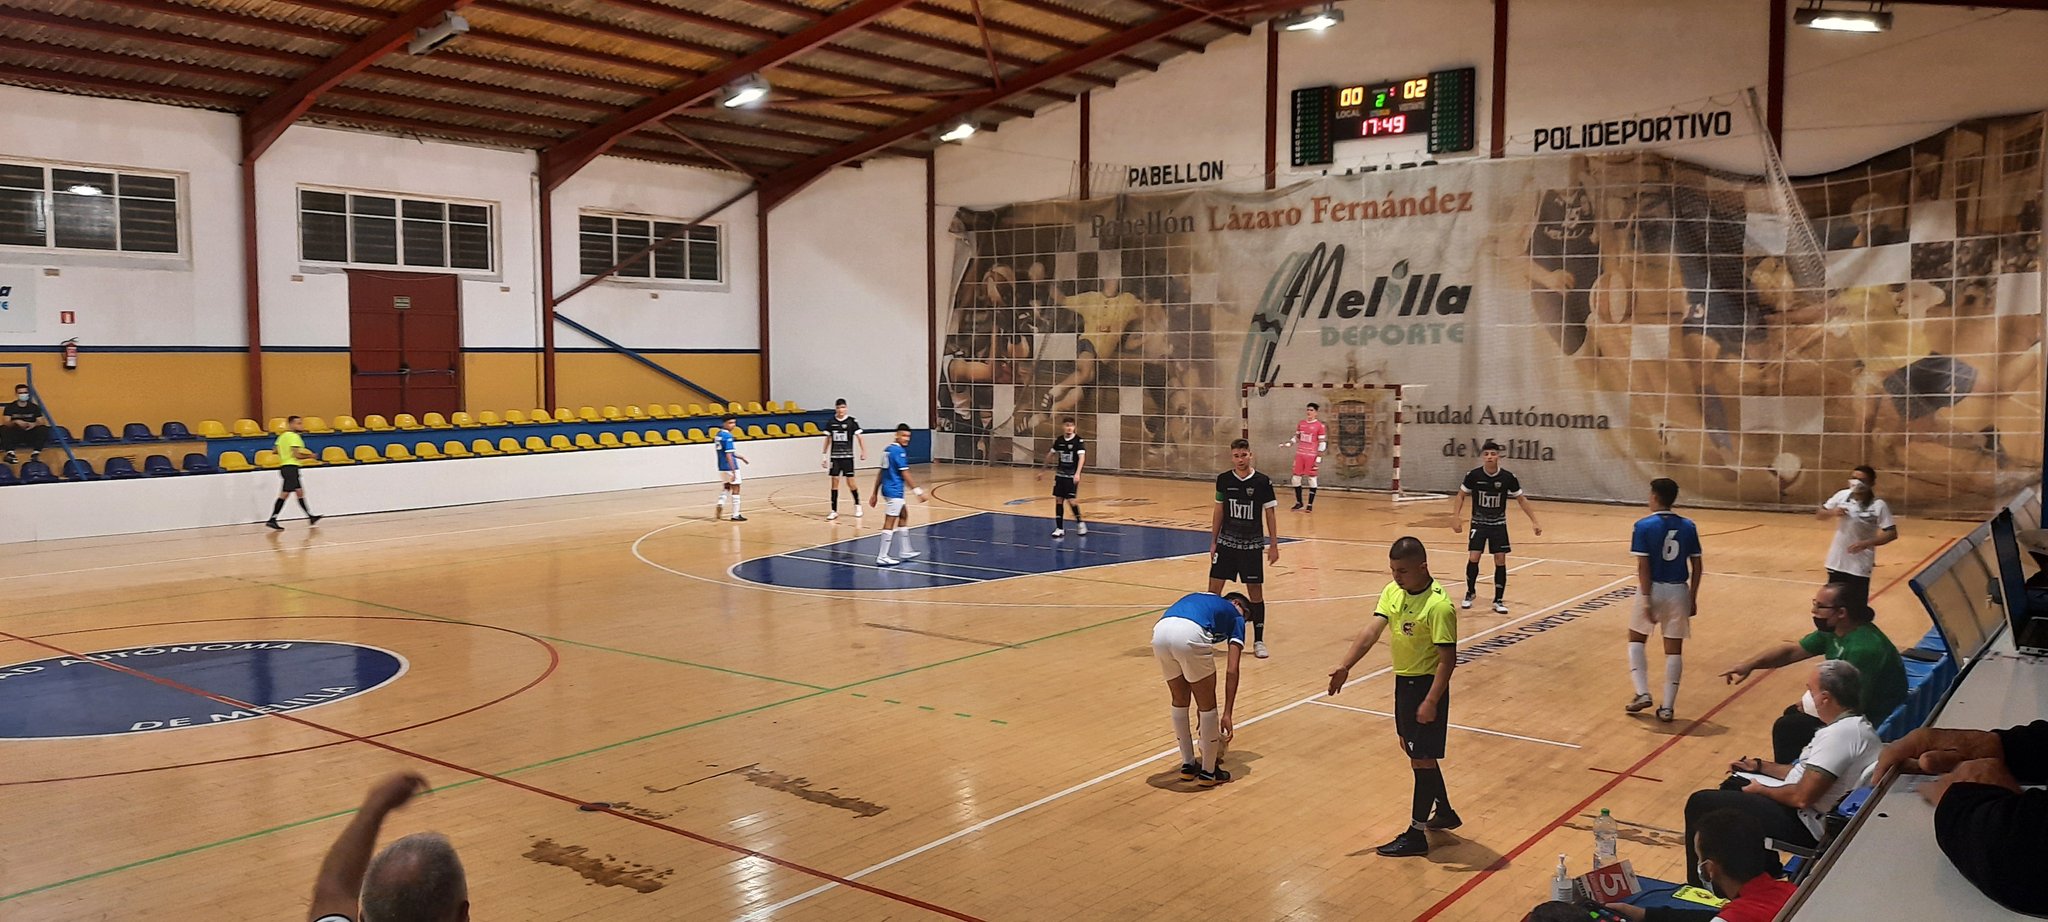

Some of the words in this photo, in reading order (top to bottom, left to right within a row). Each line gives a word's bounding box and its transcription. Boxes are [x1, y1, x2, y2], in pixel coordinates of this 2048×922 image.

[1340, 87, 1364, 107] 00
[1403, 79, 1428, 99] 02
[1375, 93, 1385, 107] 2
[1362, 114, 1406, 136] 17:49
[1534, 111, 1731, 152] POLIDEPORTIVO
[1129, 160, 1223, 187] PABELLON
[1090, 209, 1195, 239] Pabellón
[1208, 204, 1301, 233] Lázaro
[1311, 187, 1473, 224] Fernández
[1258, 242, 1472, 340] Melilla
[1321, 323, 1464, 346] DEPORTE
[1400, 405, 1473, 424] Ciudad
[1477, 405, 1610, 430] Autónoma
[1442, 438, 1465, 457] de
[1470, 529, 1477, 539] 7
[1662, 530, 1680, 562] 6
[130, 717, 192, 731] DE
[210, 685, 356, 722] MELILLA
[1600, 873, 1627, 897] 5
